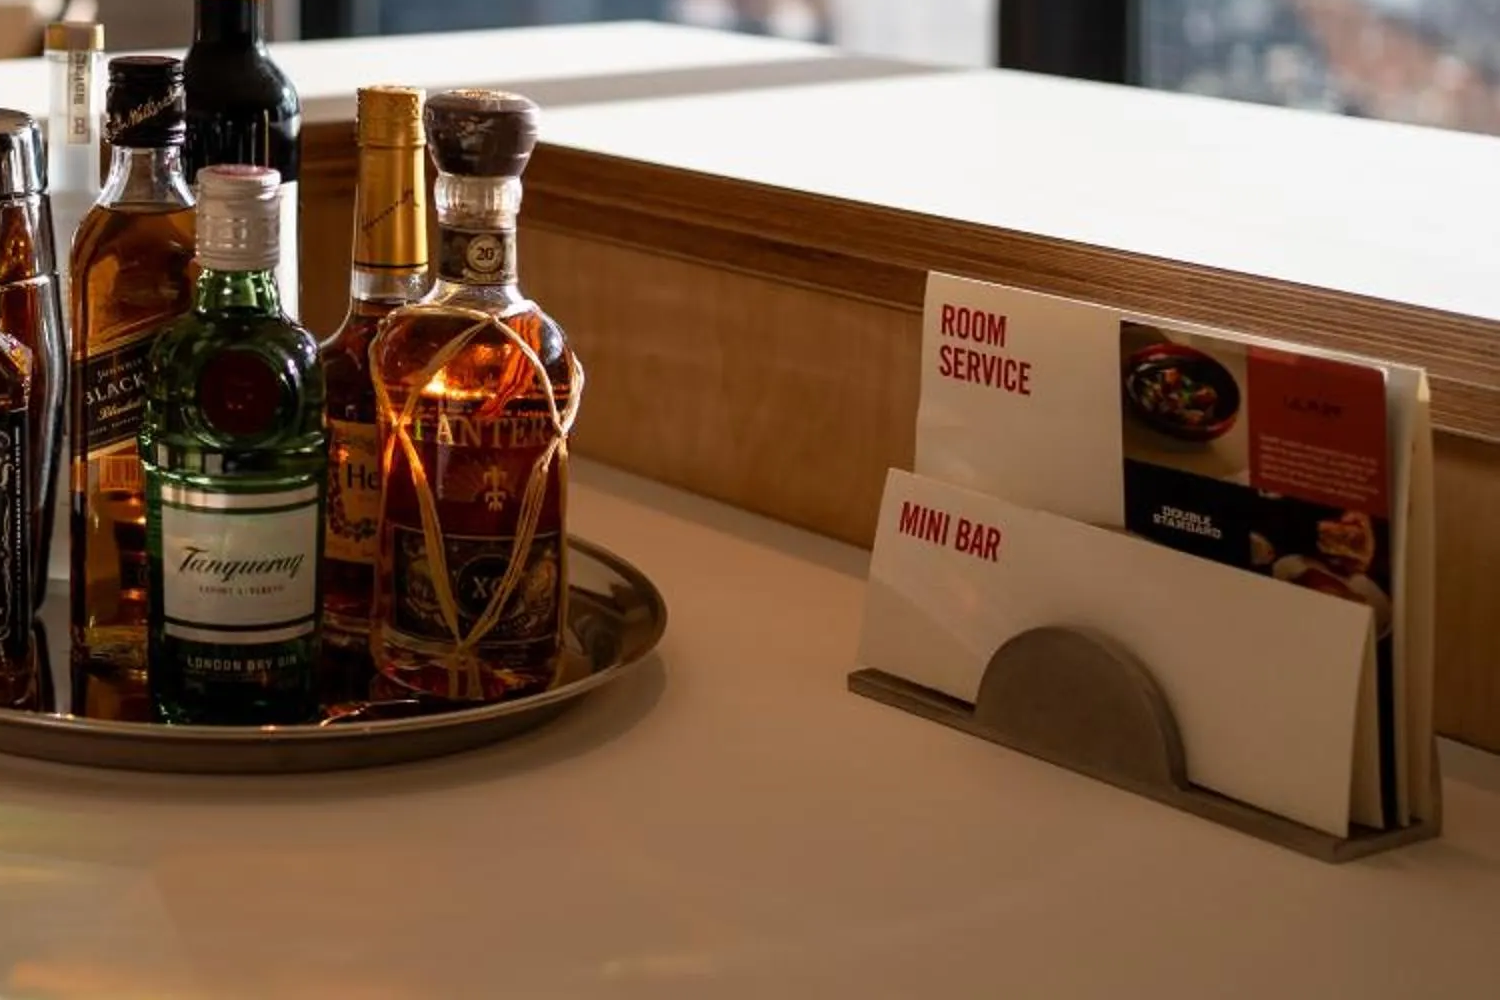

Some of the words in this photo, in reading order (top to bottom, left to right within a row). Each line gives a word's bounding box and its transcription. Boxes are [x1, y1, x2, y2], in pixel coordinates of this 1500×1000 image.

[941, 303, 1007, 348] ROOM
[939, 344, 1031, 396] SERVICE
[899, 501, 951, 546] MINI
[955, 517, 1002, 562] BAR
[178, 545, 305, 583] Tanqueray
[186, 655, 242, 671] LONDON
[247, 656, 274, 671] DRY
